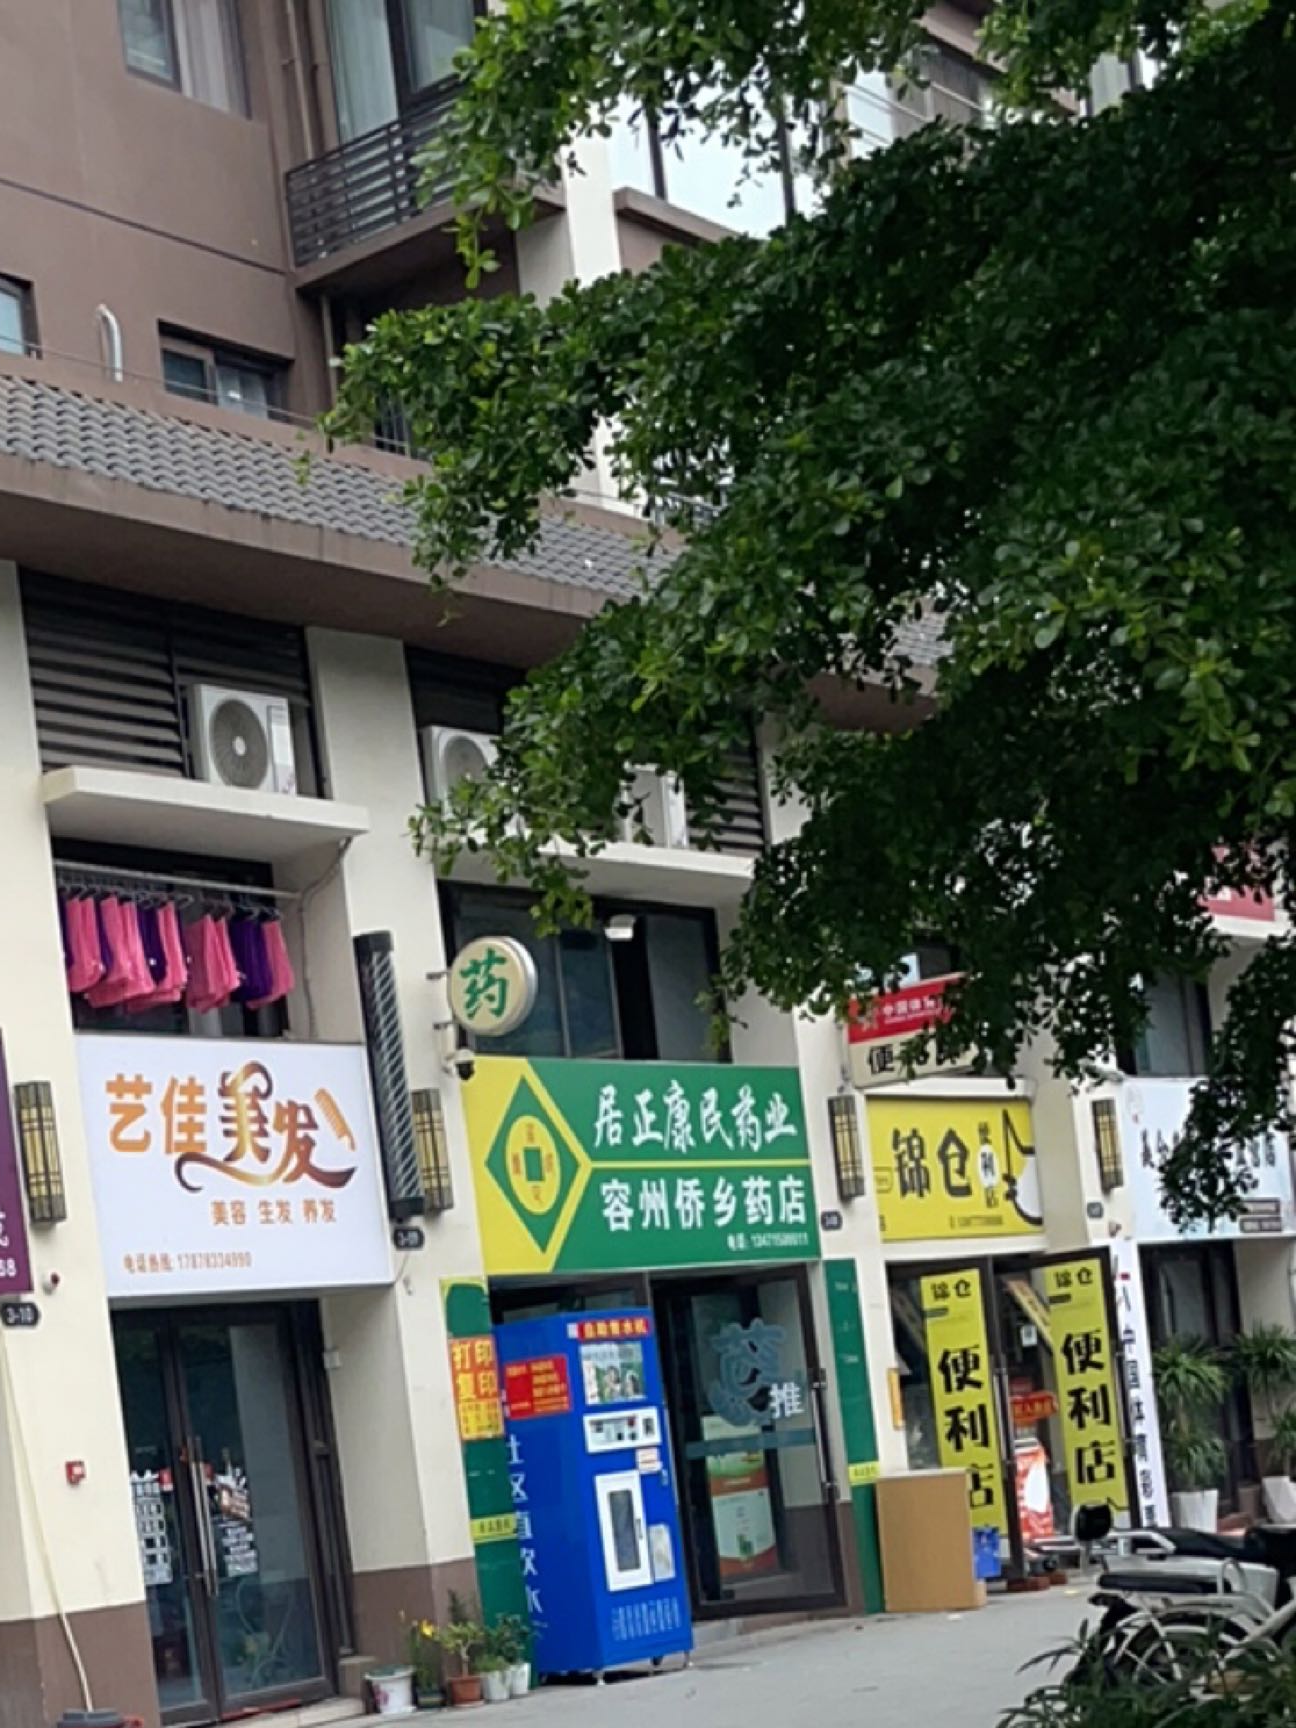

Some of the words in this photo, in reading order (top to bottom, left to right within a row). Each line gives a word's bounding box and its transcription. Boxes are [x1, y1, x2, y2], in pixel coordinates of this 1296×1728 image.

[459, 946, 507, 1020] 药
[104, 1060, 358, 1194] 艺佳美发
[593, 1079, 799, 1155] 居正康民药业
[892, 1117, 973, 1199] 锦仓
[600, 1173, 807, 1233] 容州侨乡药店
[452, 1340, 491, 1370] 打印
[457, 1370, 498, 1400] 复印
[769, 1381, 805, 1419] 推
[937, 1344, 995, 1509] 便利店
[1060, 1329, 1116, 1486] 便利店
